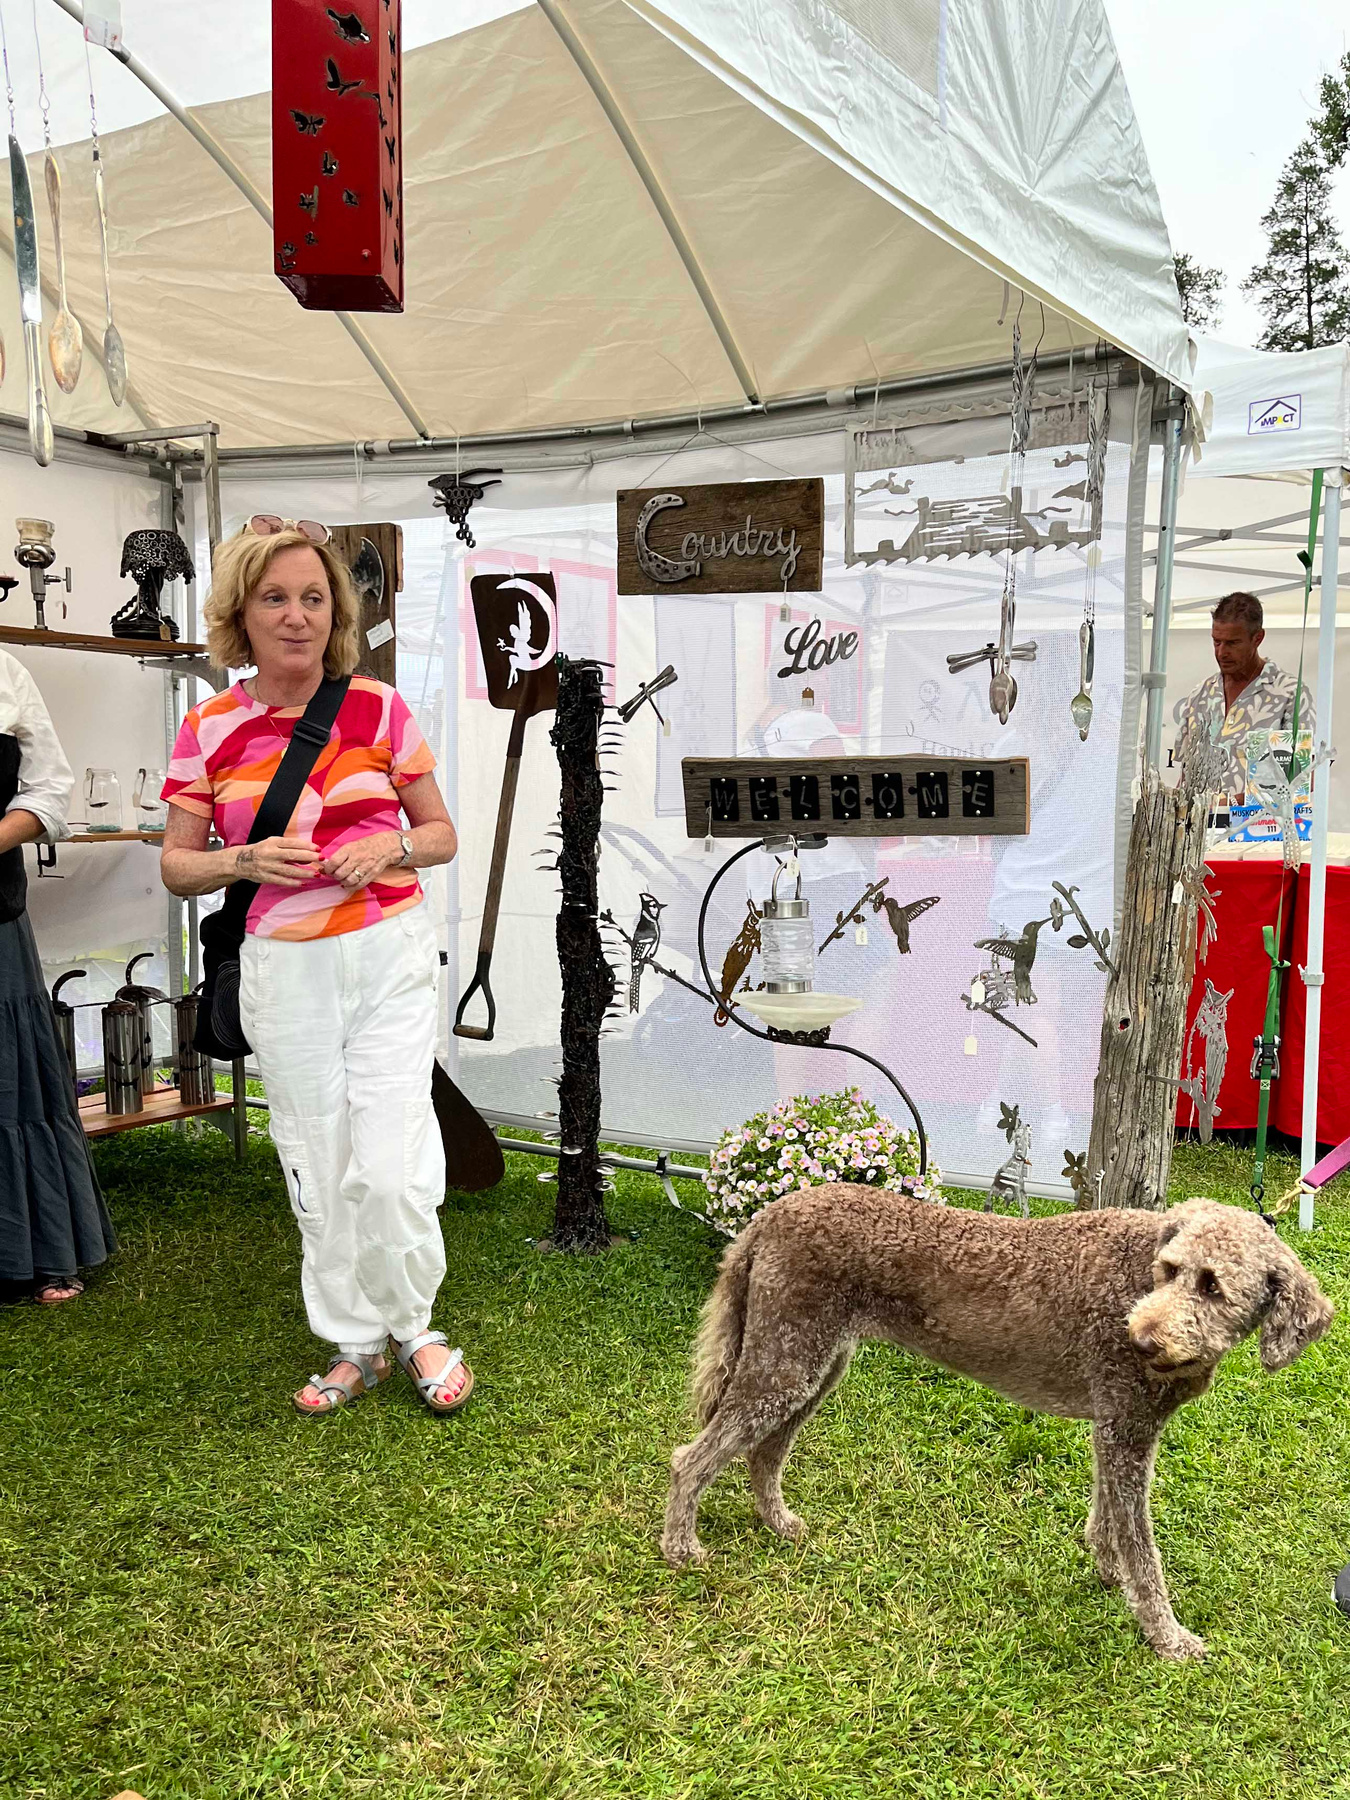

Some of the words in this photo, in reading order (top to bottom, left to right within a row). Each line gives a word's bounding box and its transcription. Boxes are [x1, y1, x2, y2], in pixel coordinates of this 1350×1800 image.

[634, 493, 802, 583] Country
[776, 618, 860, 679] Love
[714, 781, 989, 812] WELCOME
[1267, 825, 1277, 833] 111
